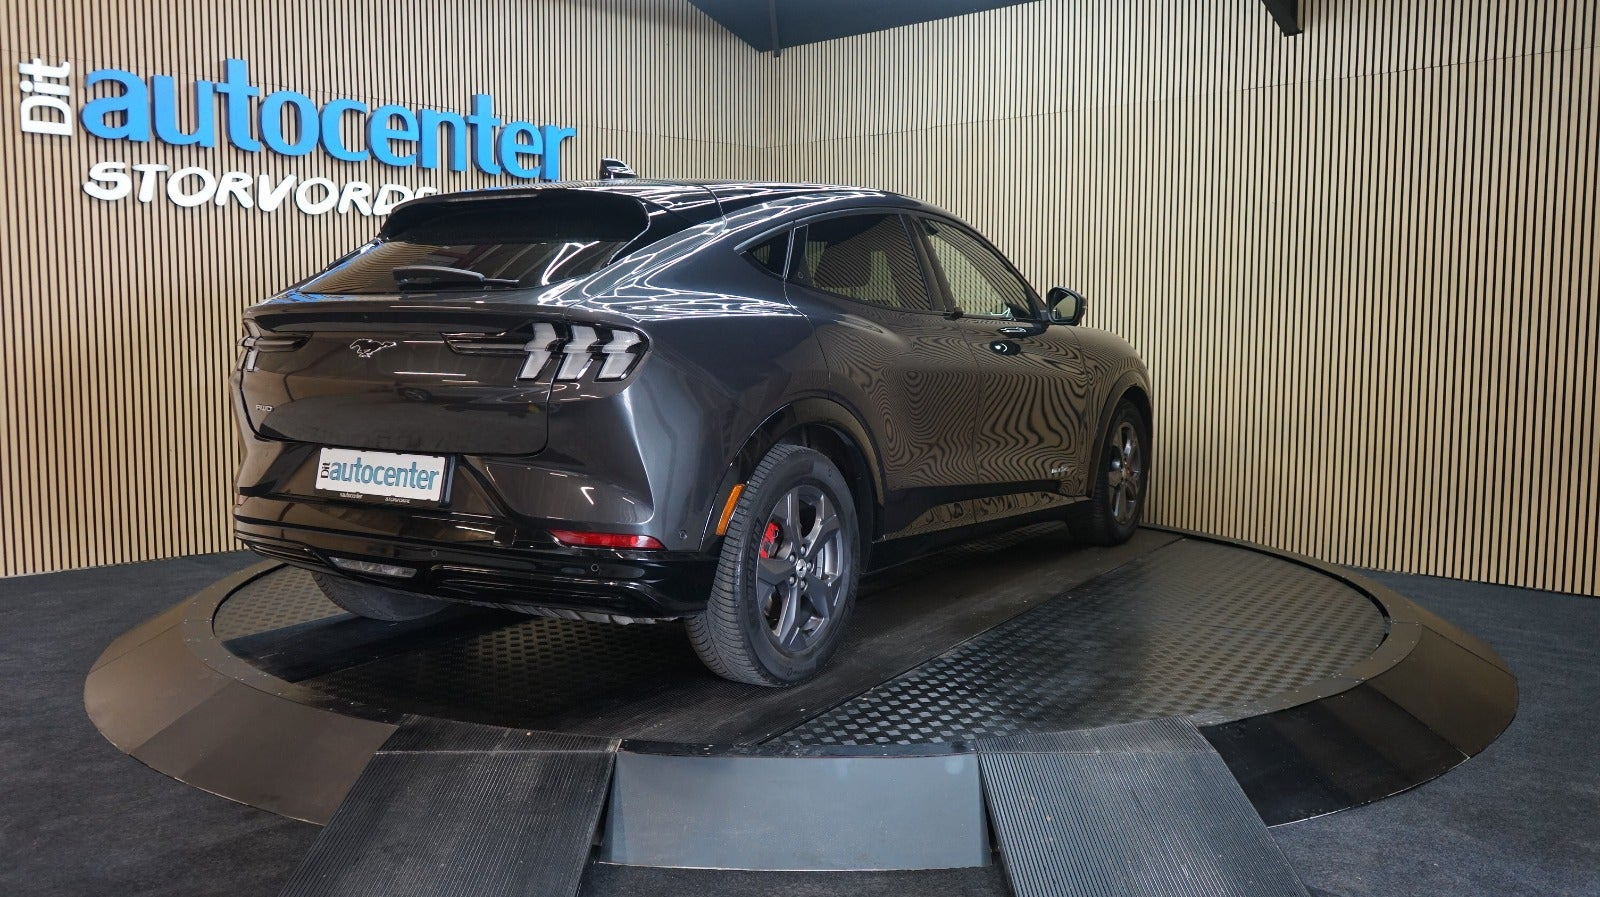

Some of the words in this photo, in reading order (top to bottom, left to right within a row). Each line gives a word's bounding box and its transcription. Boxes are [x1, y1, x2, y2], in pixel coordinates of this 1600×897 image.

[19, 58, 73, 136] Dit
[80, 58, 576, 180] autocenter
[321, 462, 330, 478] Dit
[329, 457, 439, 490] autocenter
